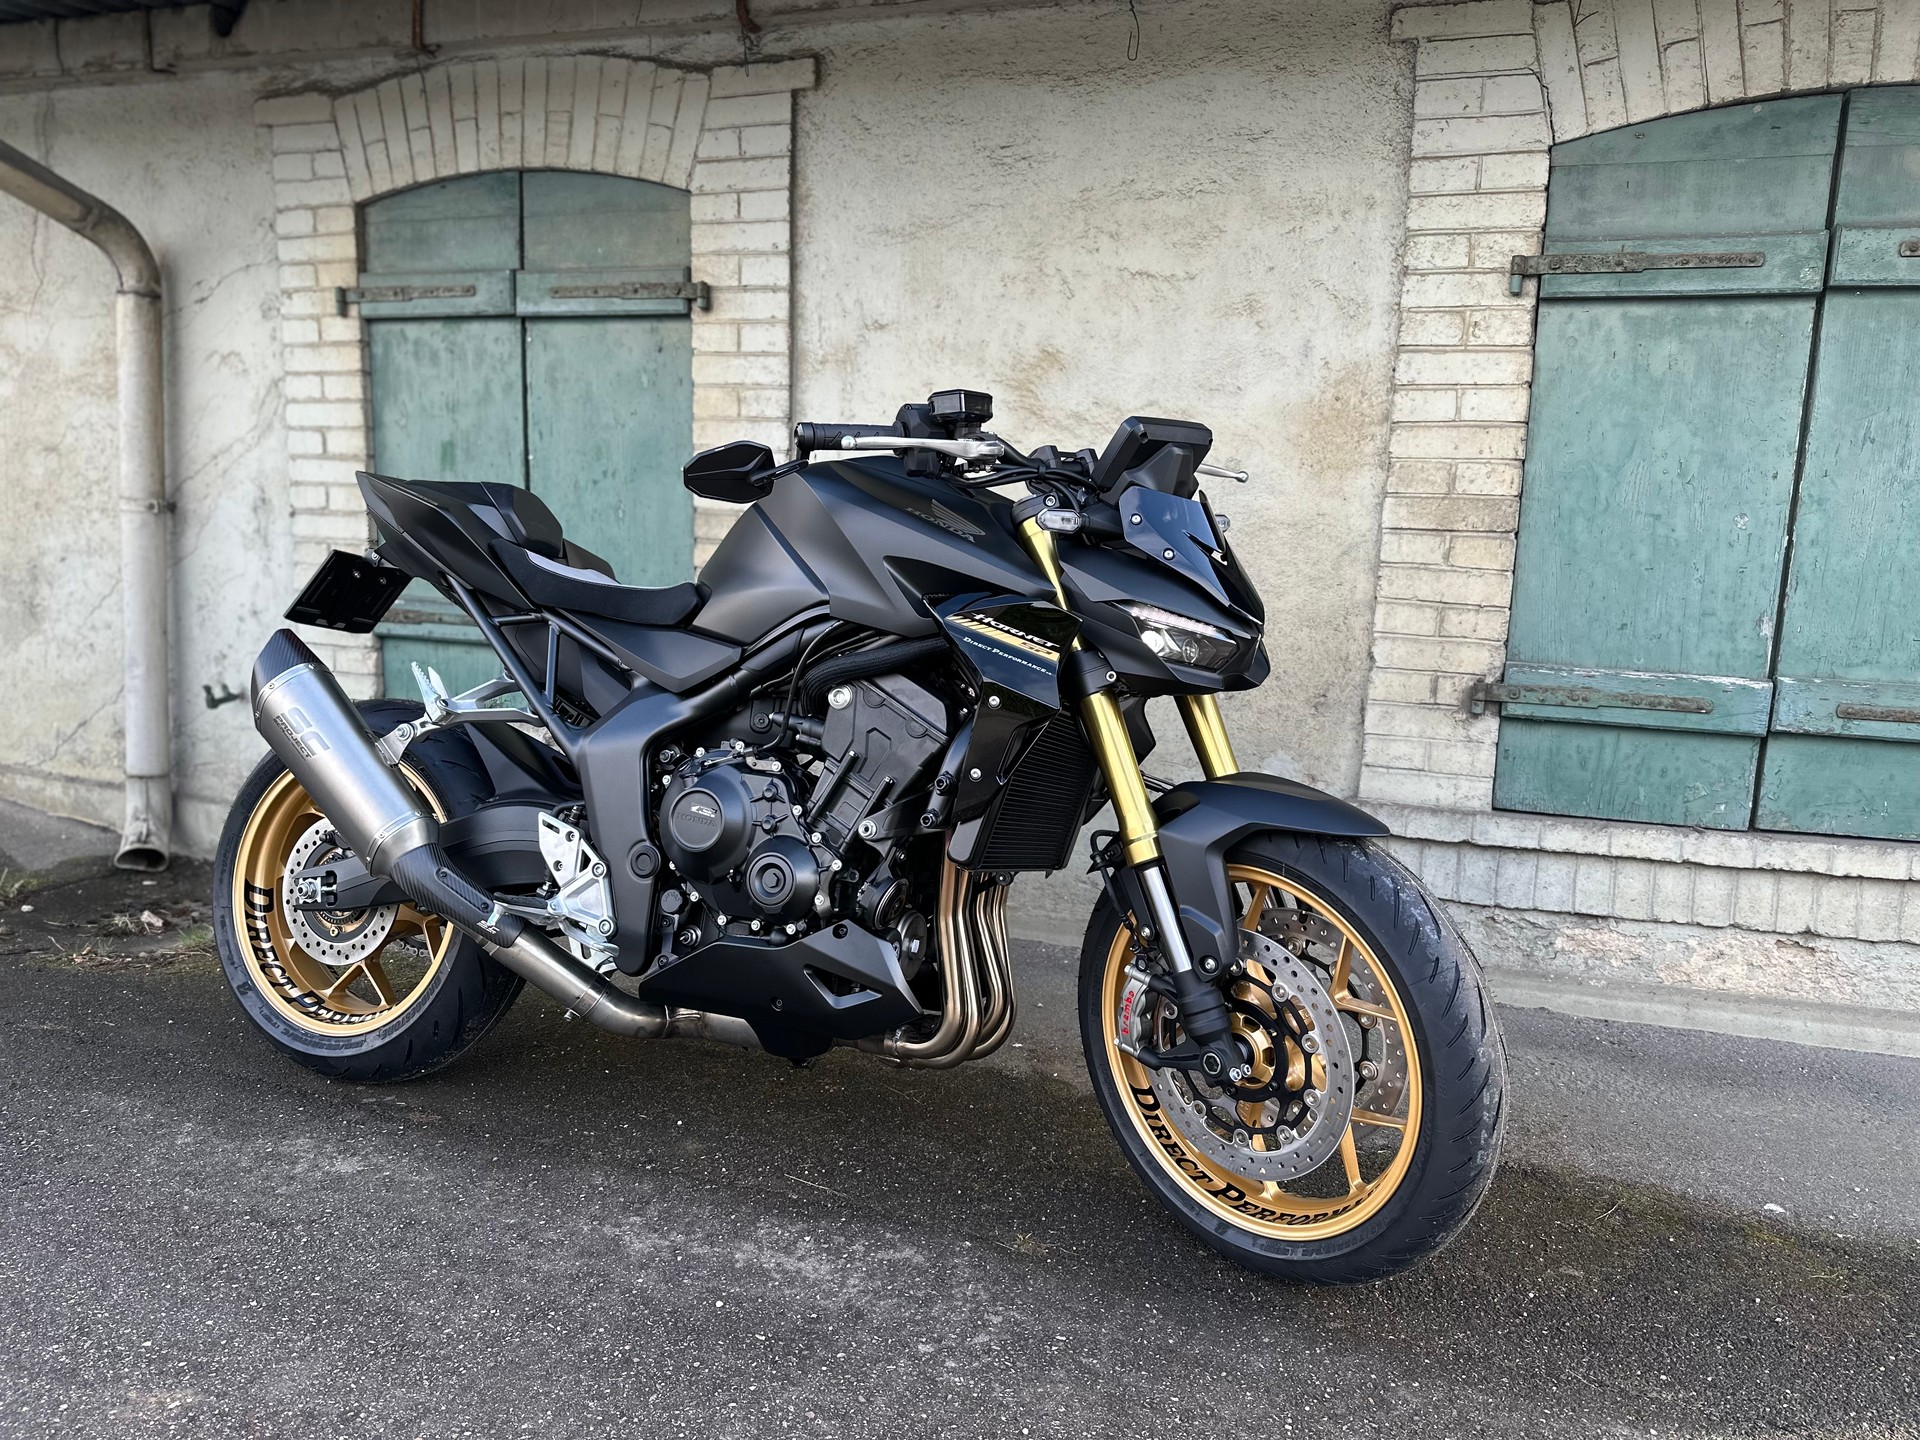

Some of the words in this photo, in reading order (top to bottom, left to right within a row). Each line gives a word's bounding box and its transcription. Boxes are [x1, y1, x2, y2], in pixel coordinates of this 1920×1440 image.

[905, 507, 976, 543] HONDA
[962, 636, 992, 652] DIRECT
[1018, 641, 1054, 656] SP
[275, 715, 312, 760] PROJECT
[281, 706, 330, 756] SC
[244, 878, 297, 991] DIRECT
[1121, 990, 1135, 1035] brembo
[1130, 1087, 1213, 1189] DIRECT
